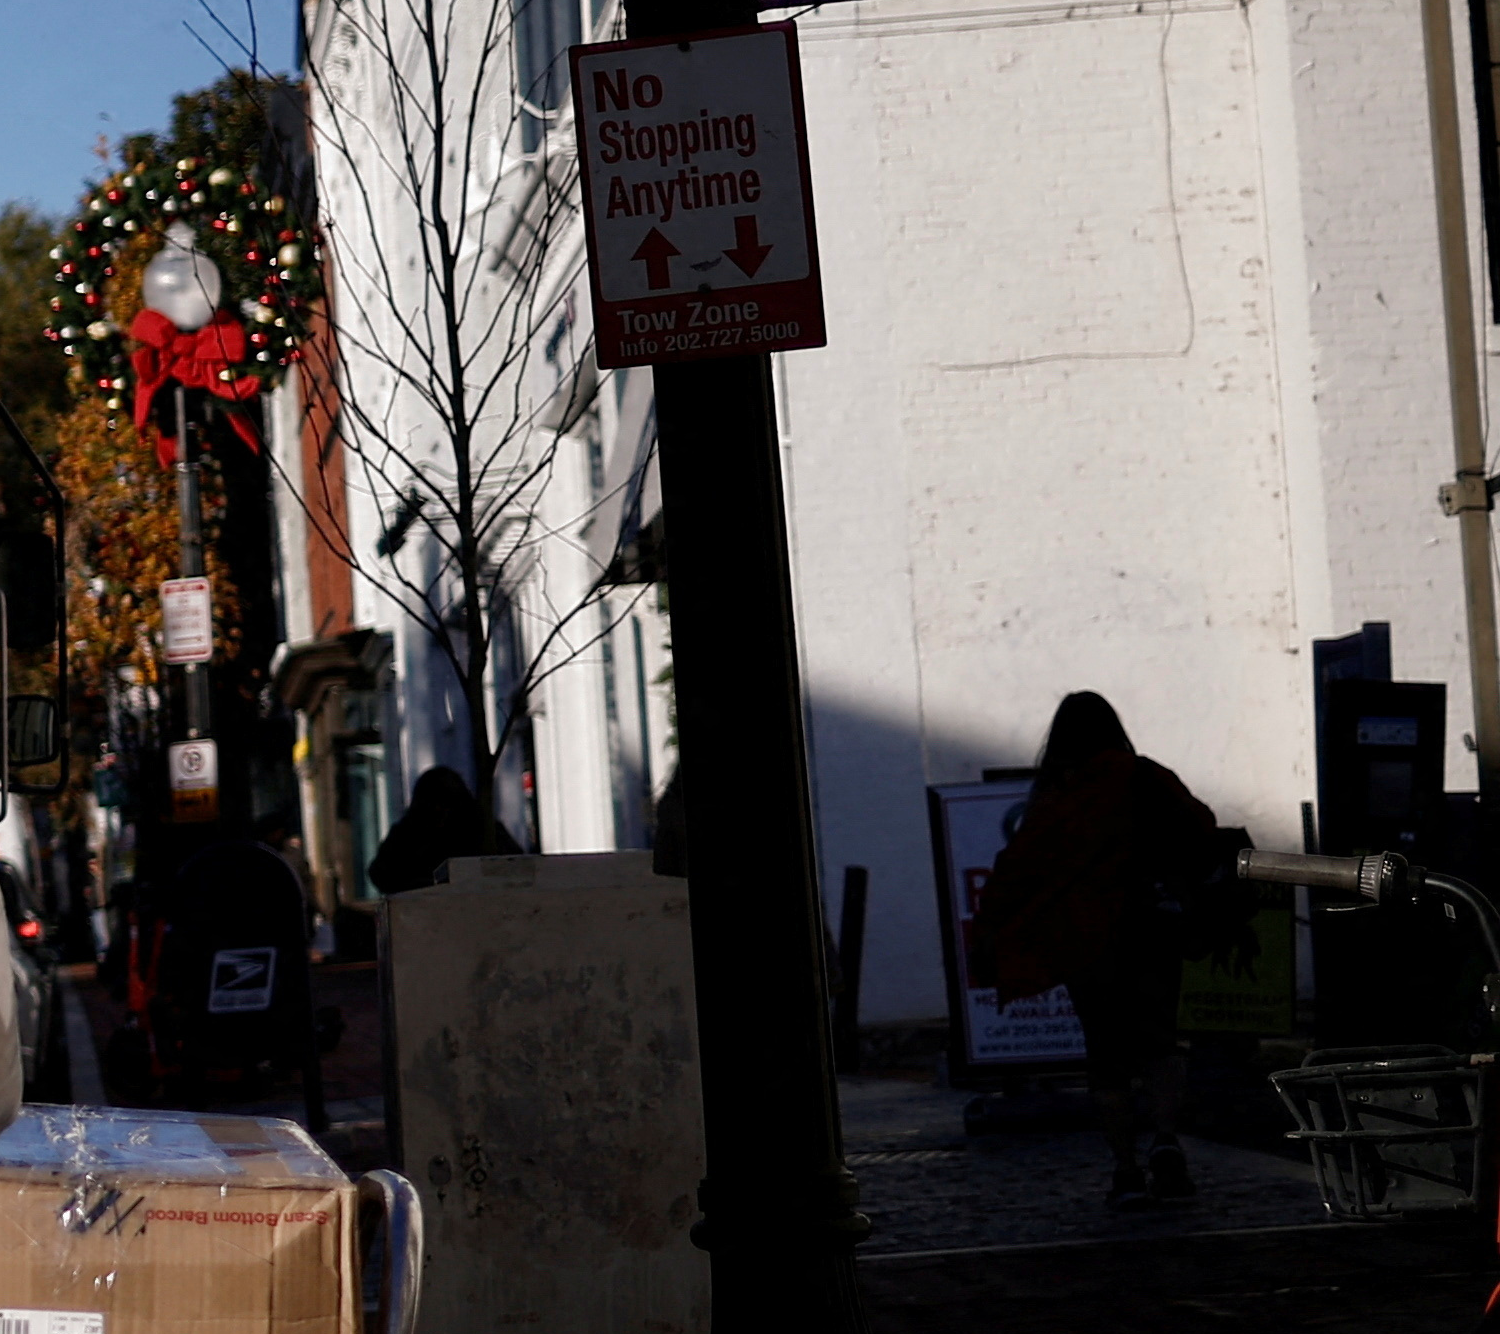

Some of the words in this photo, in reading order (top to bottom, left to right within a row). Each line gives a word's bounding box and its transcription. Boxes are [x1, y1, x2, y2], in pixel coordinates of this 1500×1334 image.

[592, 68, 663, 113] No
[600, 109, 756, 167] Stopping
[606, 167, 761, 222] Anytime
[617, 307, 676, 335] Tow
[686, 301, 760, 327] Zone
[620, 337, 658, 357] Info
[664, 321, 800, 352] 202.727.5000
[145, 1209, 208, 1225] Barcod
[213, 1210, 278, 1227] Bottom
[284, 1210, 329, 1225] Scan
